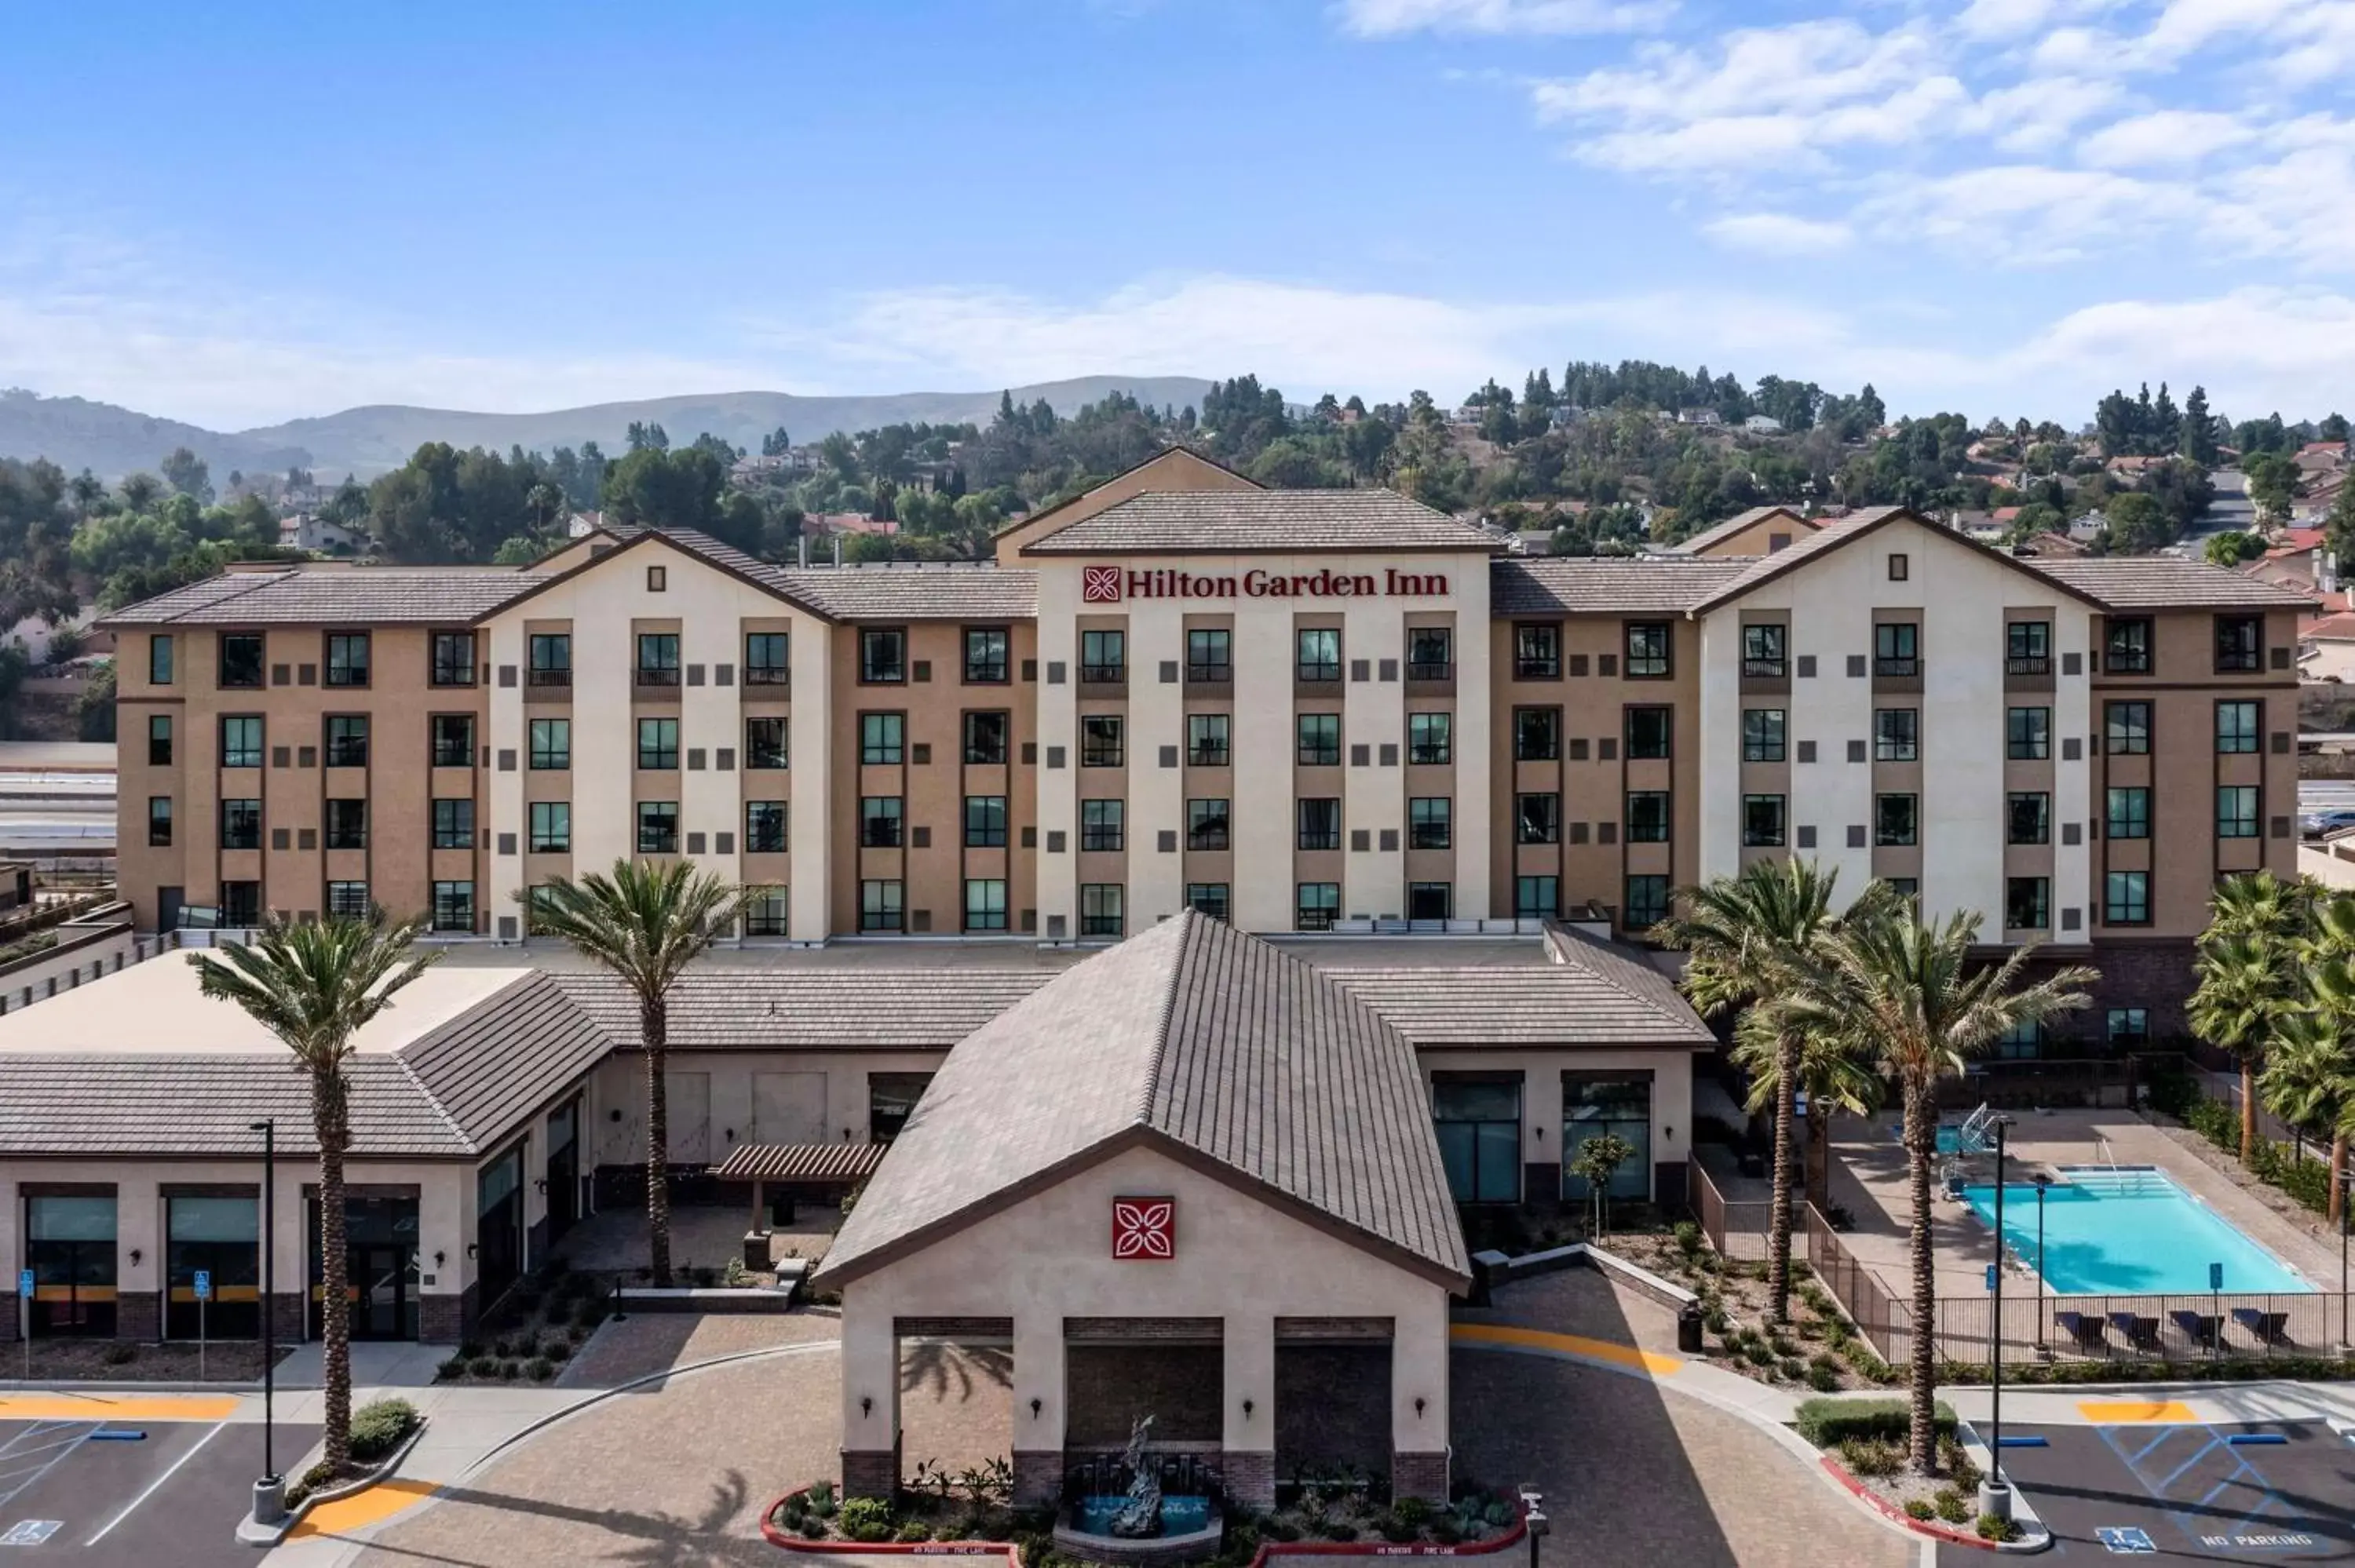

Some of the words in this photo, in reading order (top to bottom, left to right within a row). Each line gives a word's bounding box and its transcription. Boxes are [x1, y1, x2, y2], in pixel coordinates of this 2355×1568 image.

[1126, 569, 1237, 597] Hilton
[1243, 569, 1377, 597] Garden
[1384, 568, 1449, 596] Inn
[2201, 1535, 2229, 1545] NO
[2235, 1535, 2313, 1545] PARKING
